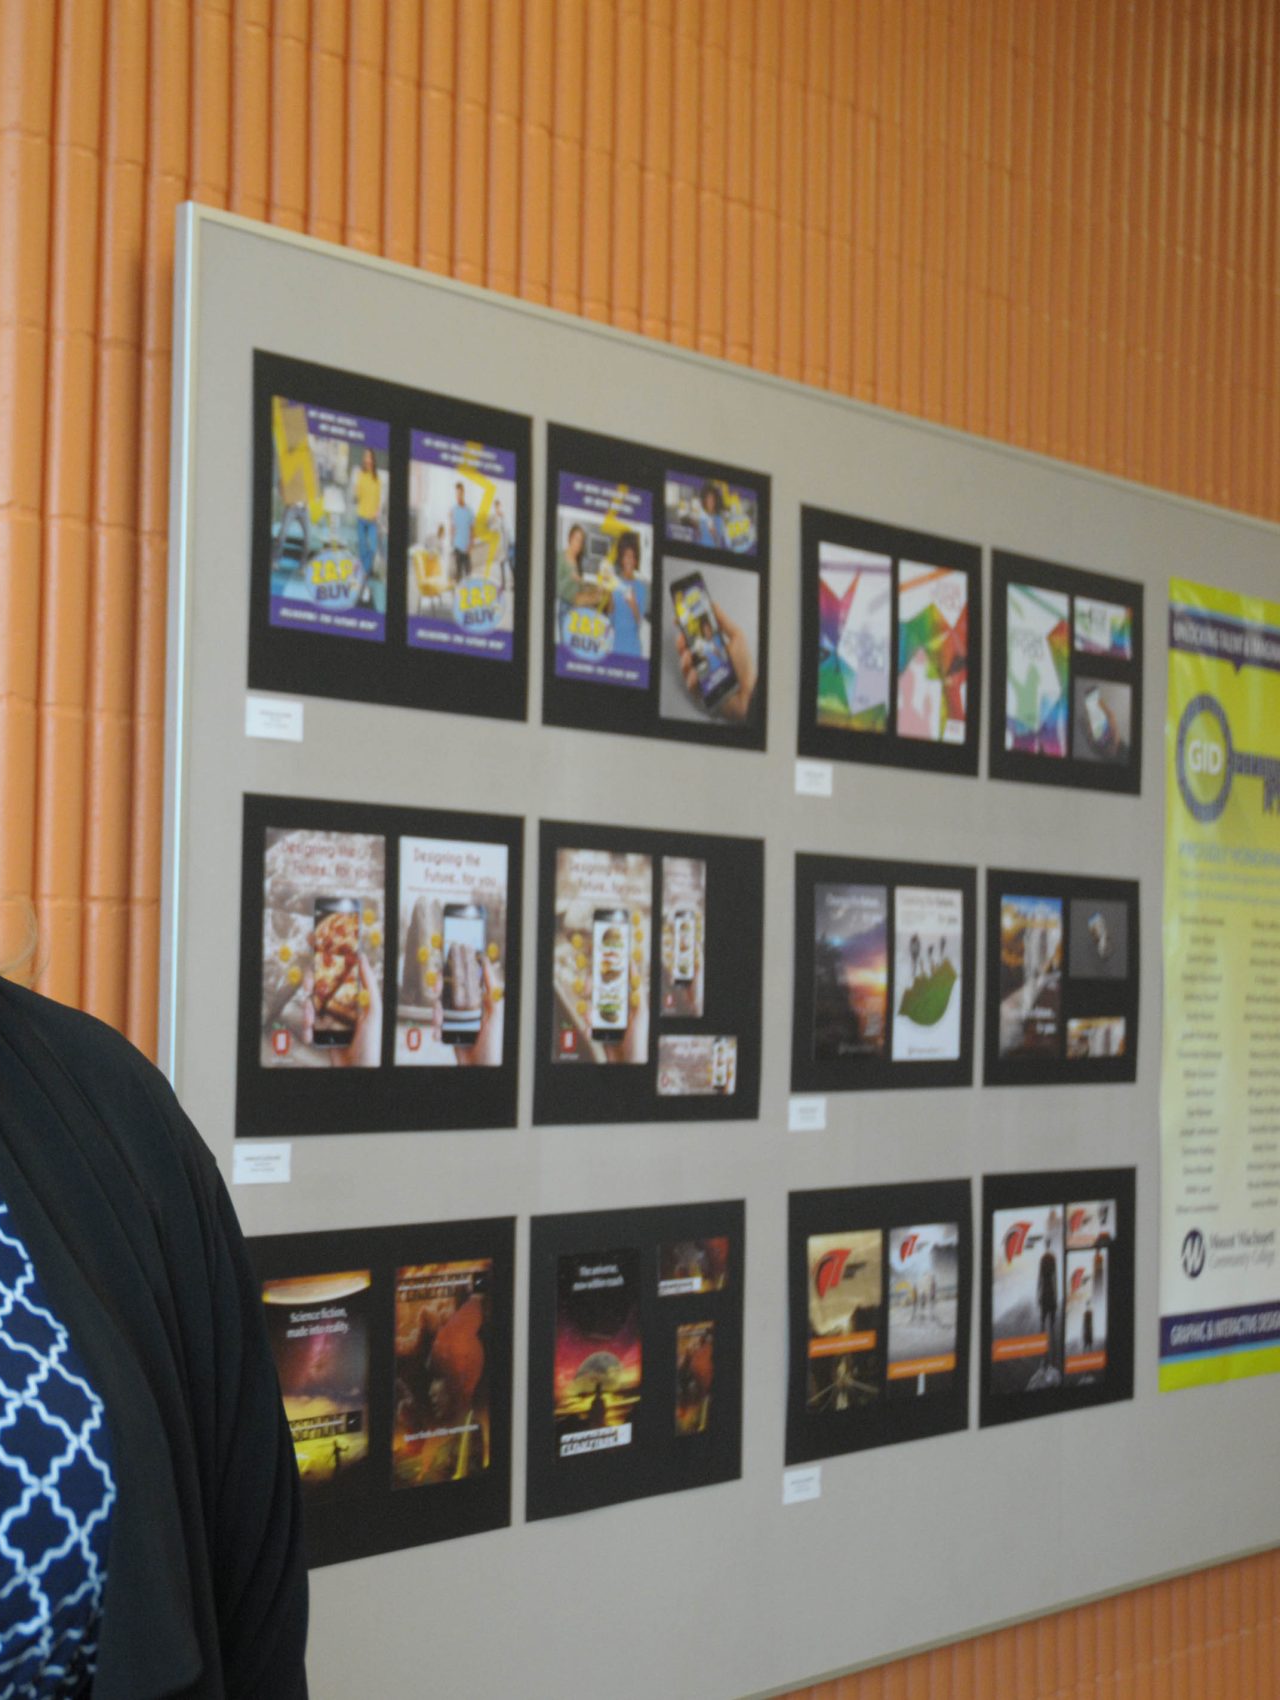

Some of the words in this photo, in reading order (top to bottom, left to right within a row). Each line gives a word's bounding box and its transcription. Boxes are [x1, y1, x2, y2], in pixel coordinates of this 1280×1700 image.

[290, 1311, 320, 1323] Science
[286, 1326, 309, 1338] made
[309, 1325, 326, 1336] into
